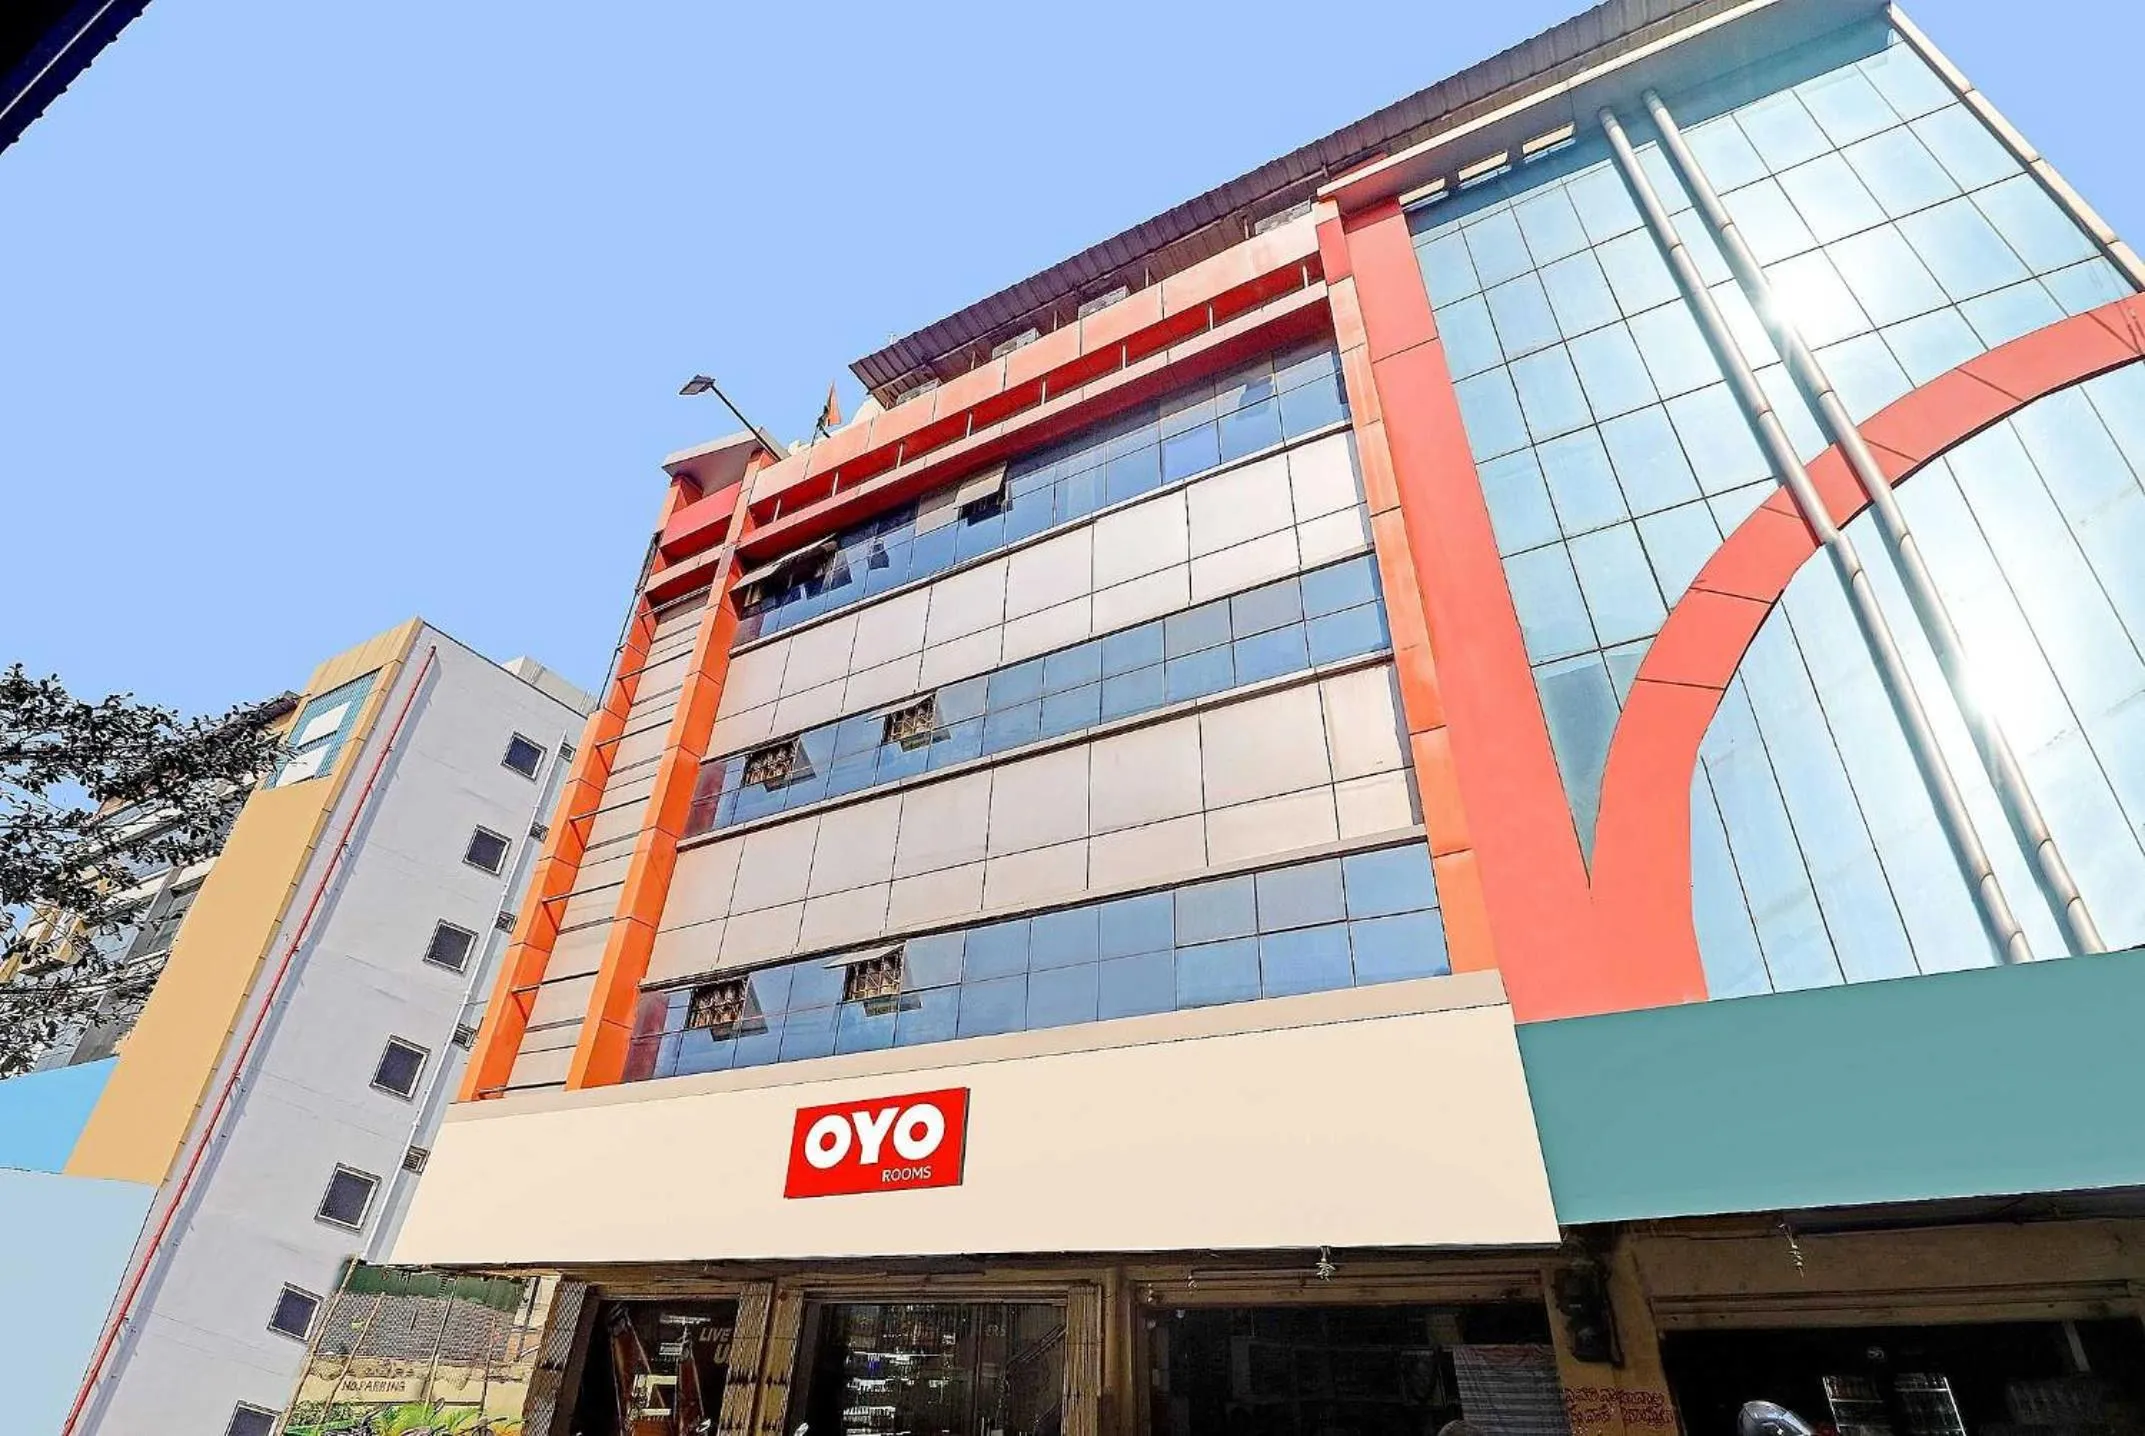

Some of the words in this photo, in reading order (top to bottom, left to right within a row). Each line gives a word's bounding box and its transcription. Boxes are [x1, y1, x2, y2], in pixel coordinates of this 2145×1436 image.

[805, 1103, 945, 1169] OYO
[881, 1166, 932, 1182] ROOMS
[700, 1327, 731, 1342] LIVE
